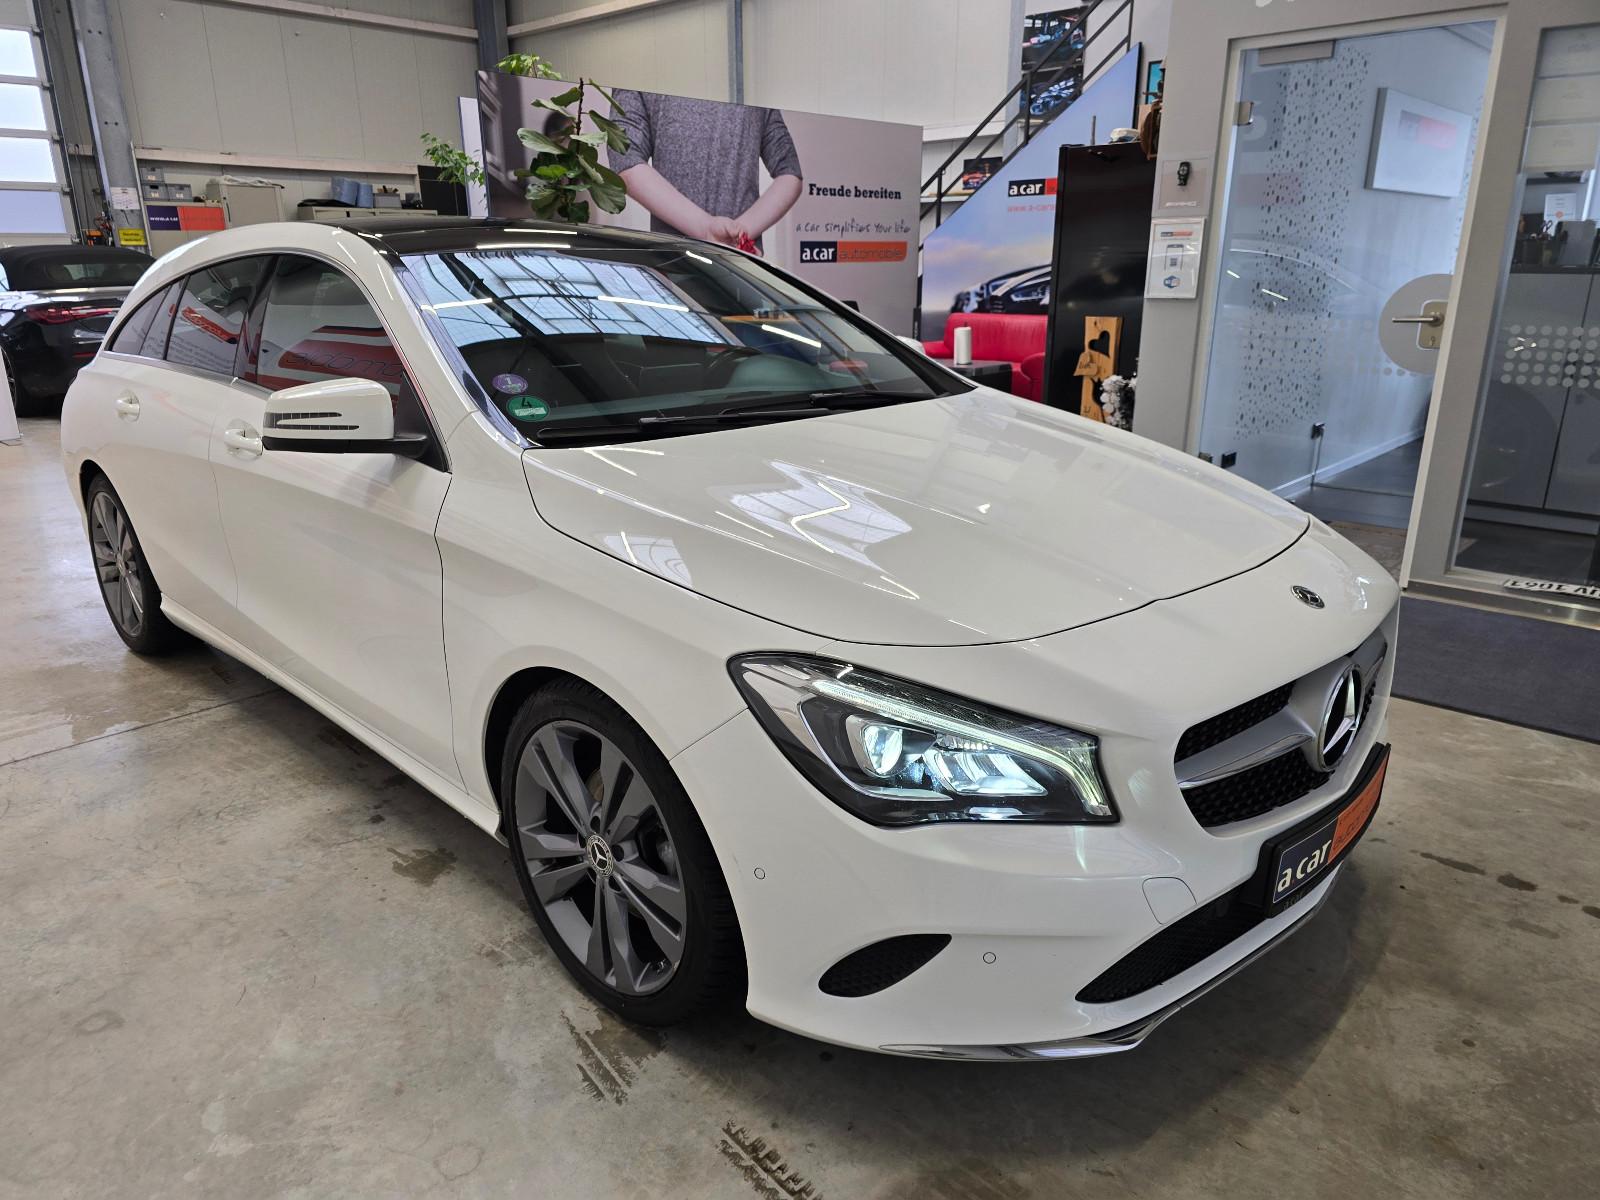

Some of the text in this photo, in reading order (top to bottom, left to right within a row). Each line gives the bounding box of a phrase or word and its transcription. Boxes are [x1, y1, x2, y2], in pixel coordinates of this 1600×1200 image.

[808, 183, 901, 200] Freude bereiten
[804, 222, 820, 232] car
[521, 397, 532, 407] 4
